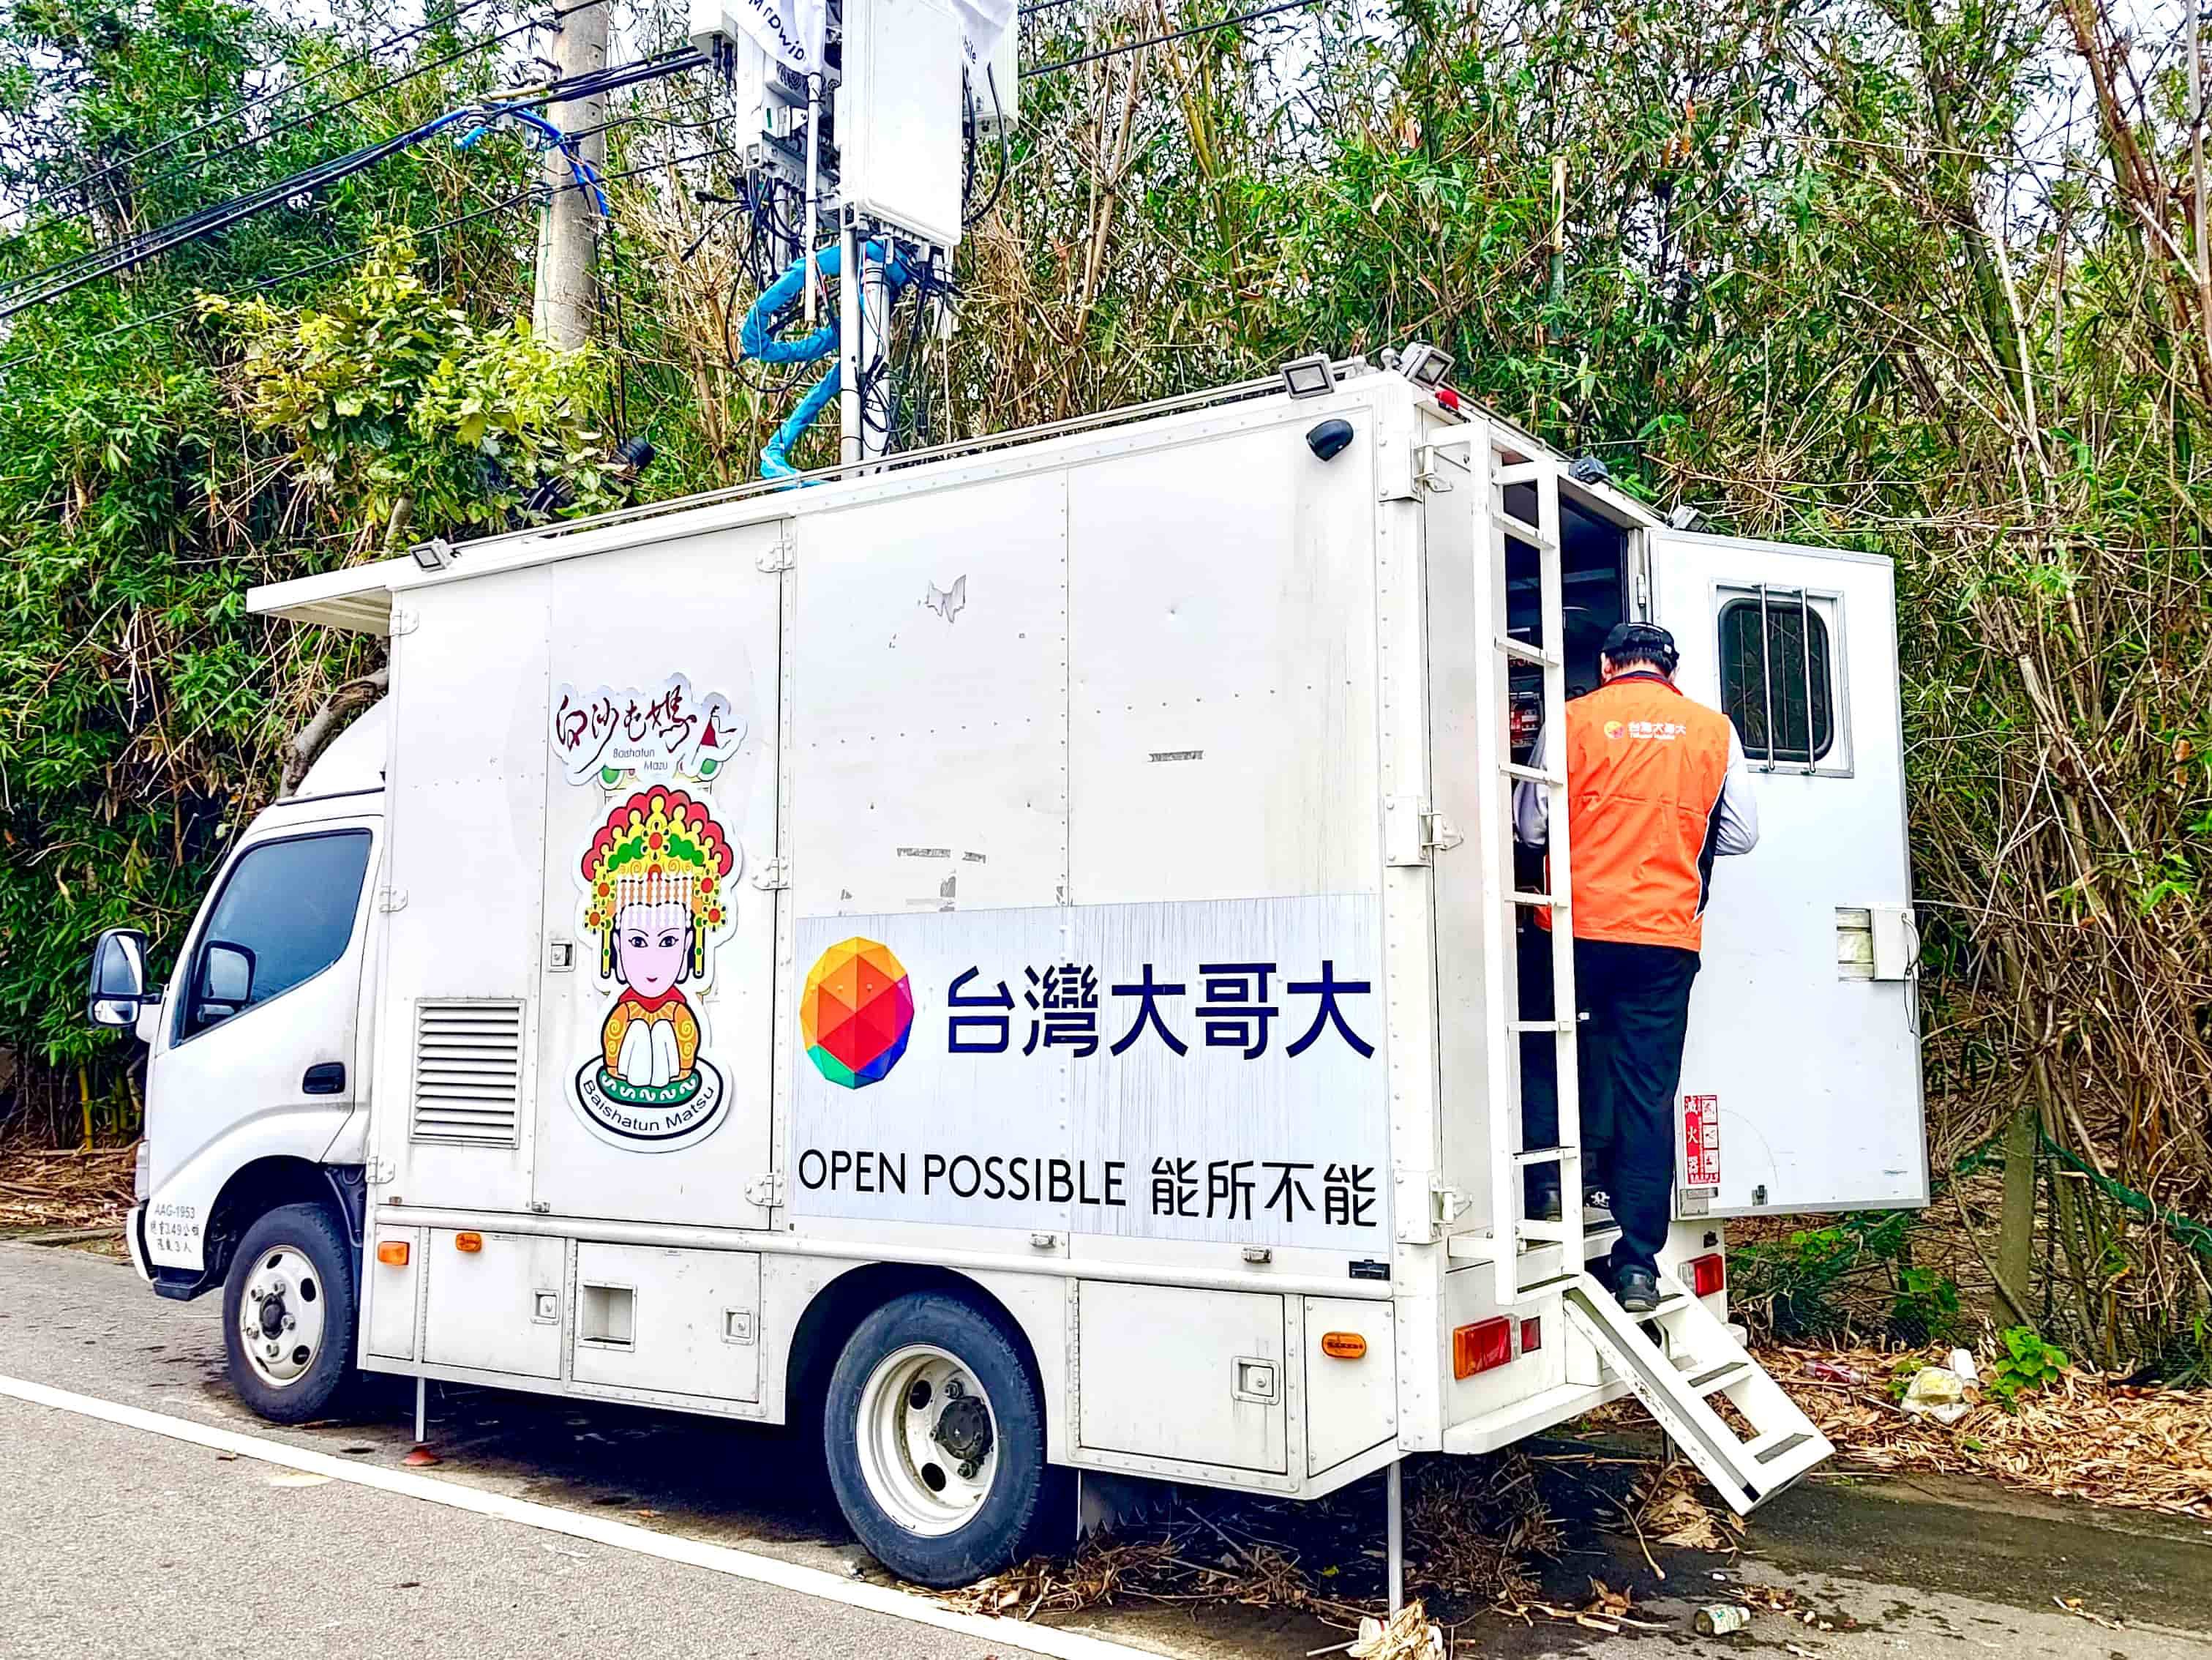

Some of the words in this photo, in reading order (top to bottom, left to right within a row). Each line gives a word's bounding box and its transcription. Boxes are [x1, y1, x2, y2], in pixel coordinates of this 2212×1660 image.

[612, 748, 656, 759] Baishatun
[643, 760, 669, 770] Mazu
[947, 960, 1376, 1061] 台灣大哥大
[583, 1080, 660, 1132] Baishatun
[665, 1085, 715, 1130] Matsu
[798, 1148, 906, 1194] OPEN
[924, 1154, 1127, 1207] POSSIBLE
[1151, 1156, 1378, 1228] 能所不能
[154, 1203, 195, 1219] AAG-1953
